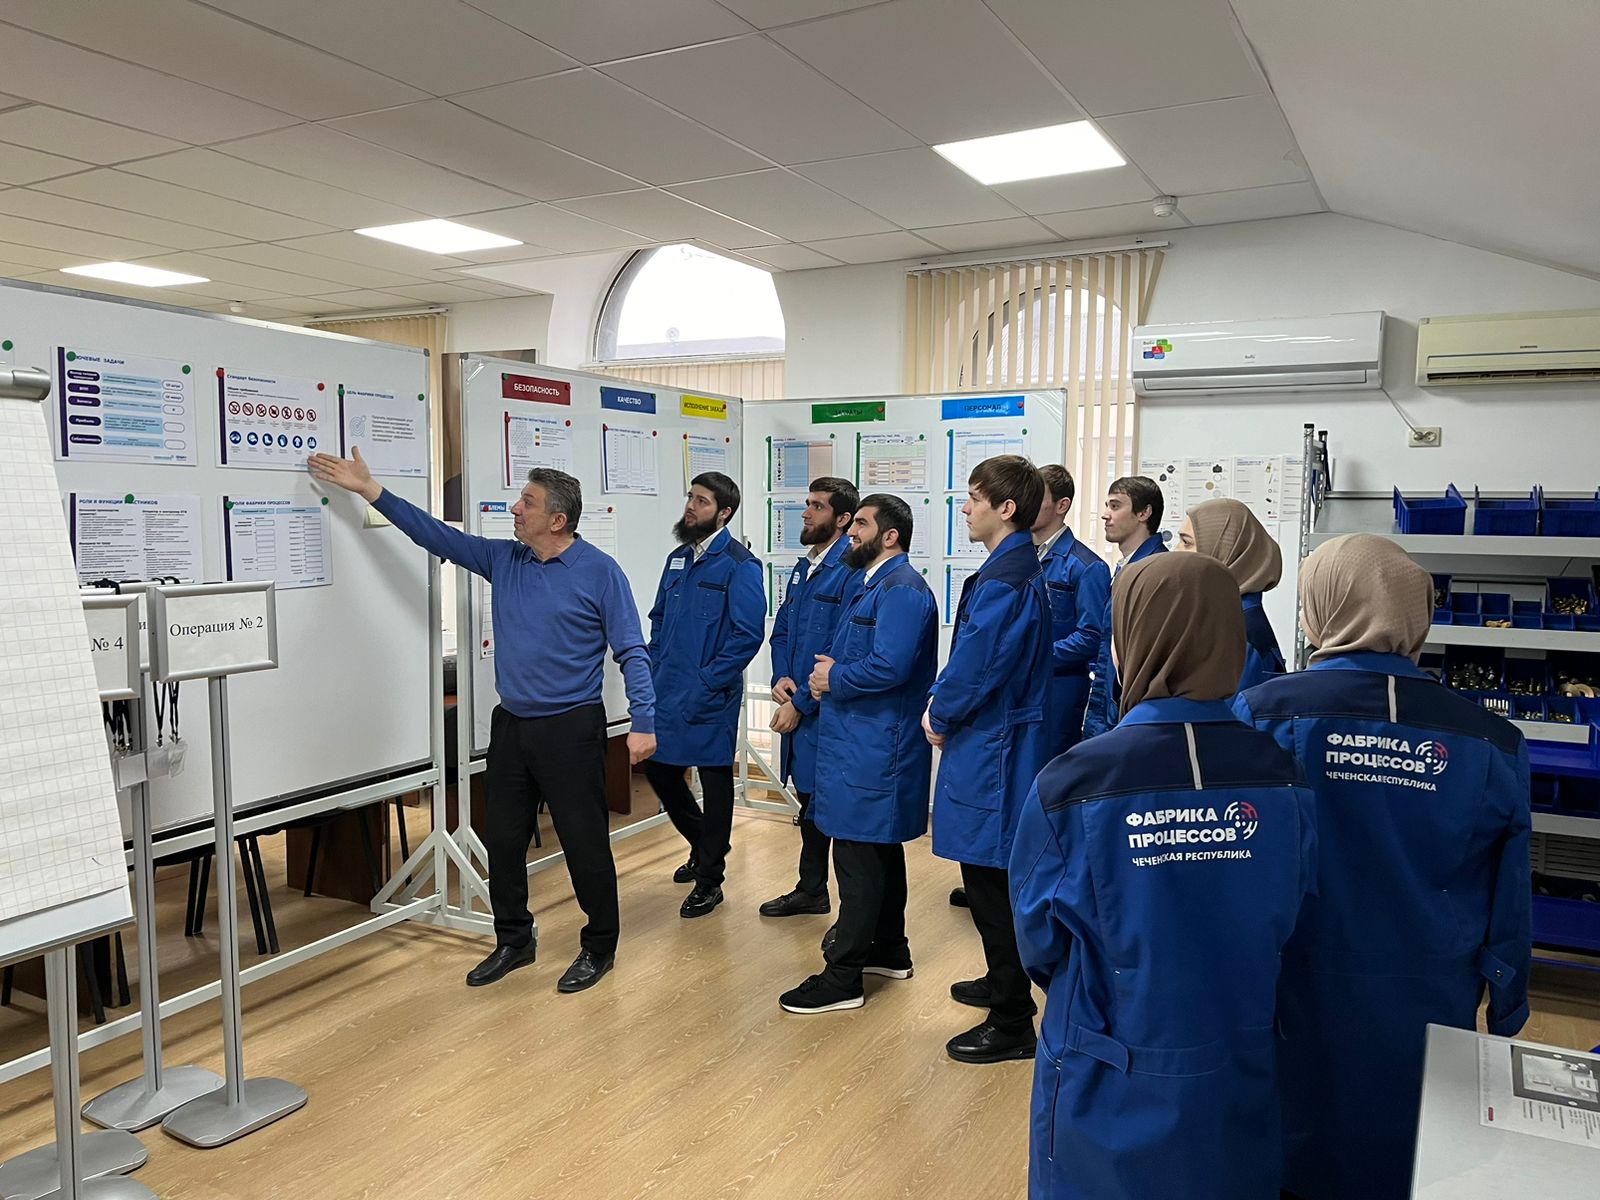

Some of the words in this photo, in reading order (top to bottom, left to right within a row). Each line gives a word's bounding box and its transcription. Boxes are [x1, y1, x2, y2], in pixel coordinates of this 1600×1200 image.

[514, 383, 560, 397] БЕЗОПАСНОСТЬ
[617, 396, 642, 406] КАЧЕСТВО
[170, 621, 235, 637] Операция
[239, 617, 253, 629] №
[256, 616, 263, 628] 2
[114, 637, 124, 650] 4
[1326, 733, 1411, 753] ФАБРИКА
[1326, 751, 1426, 774] ПРОЦЕССОВ
[1125, 807, 1218, 827] ФАБРИКА
[1128, 827, 1237, 848] ПРОЦЕССОВ
[1185, 849, 1252, 861] РЕСПУБЛИКА
